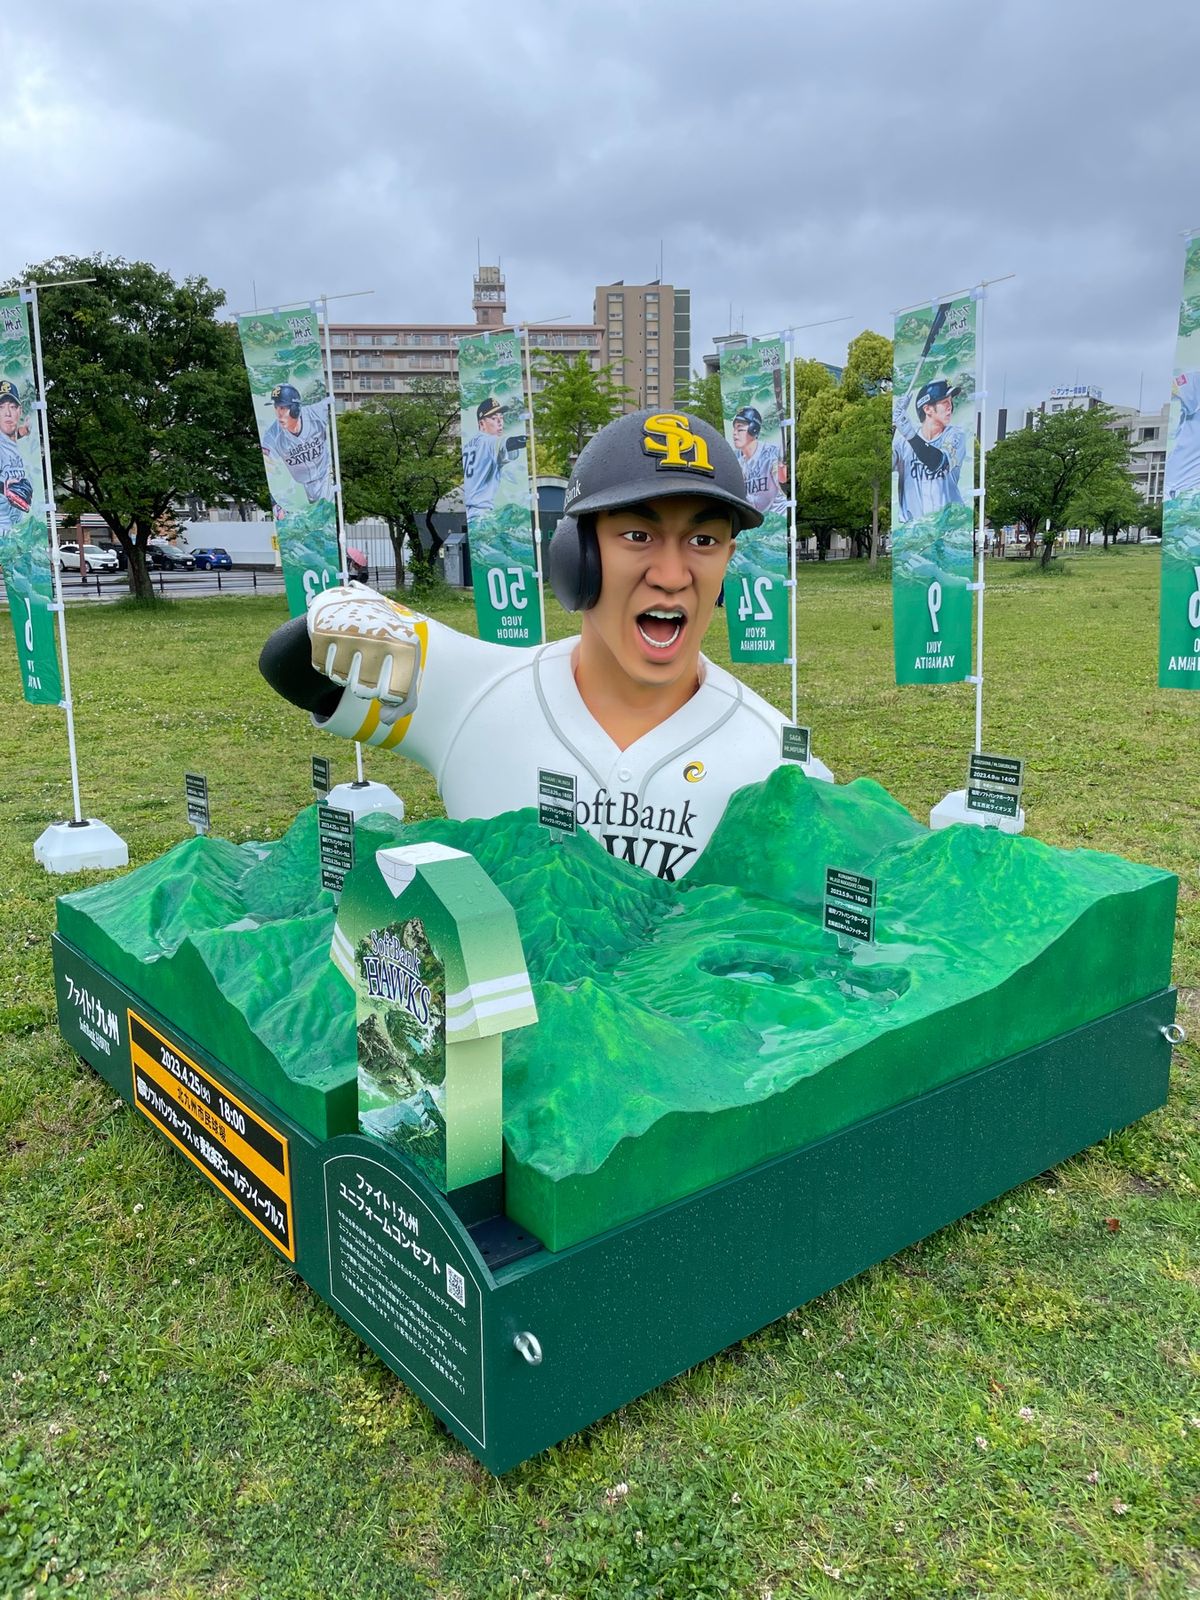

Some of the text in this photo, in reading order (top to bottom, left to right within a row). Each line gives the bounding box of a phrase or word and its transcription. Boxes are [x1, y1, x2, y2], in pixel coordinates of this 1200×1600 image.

[576, 788, 697, 838] oftBank
[371, 929, 421, 977] SoftBank
[364, 957, 431, 1025] HAWKS
[177, 1086, 226, 1143] 北九州市民球場
[219, 1097, 246, 1135] 18:00
[137, 1075, 192, 1141] 福岡ソフトバンクホークス
[200, 1136, 286, 1234] 東北楽天ゴールデンイーグルス
[340, 1182, 441, 1275] ユニフォームコンセプト
